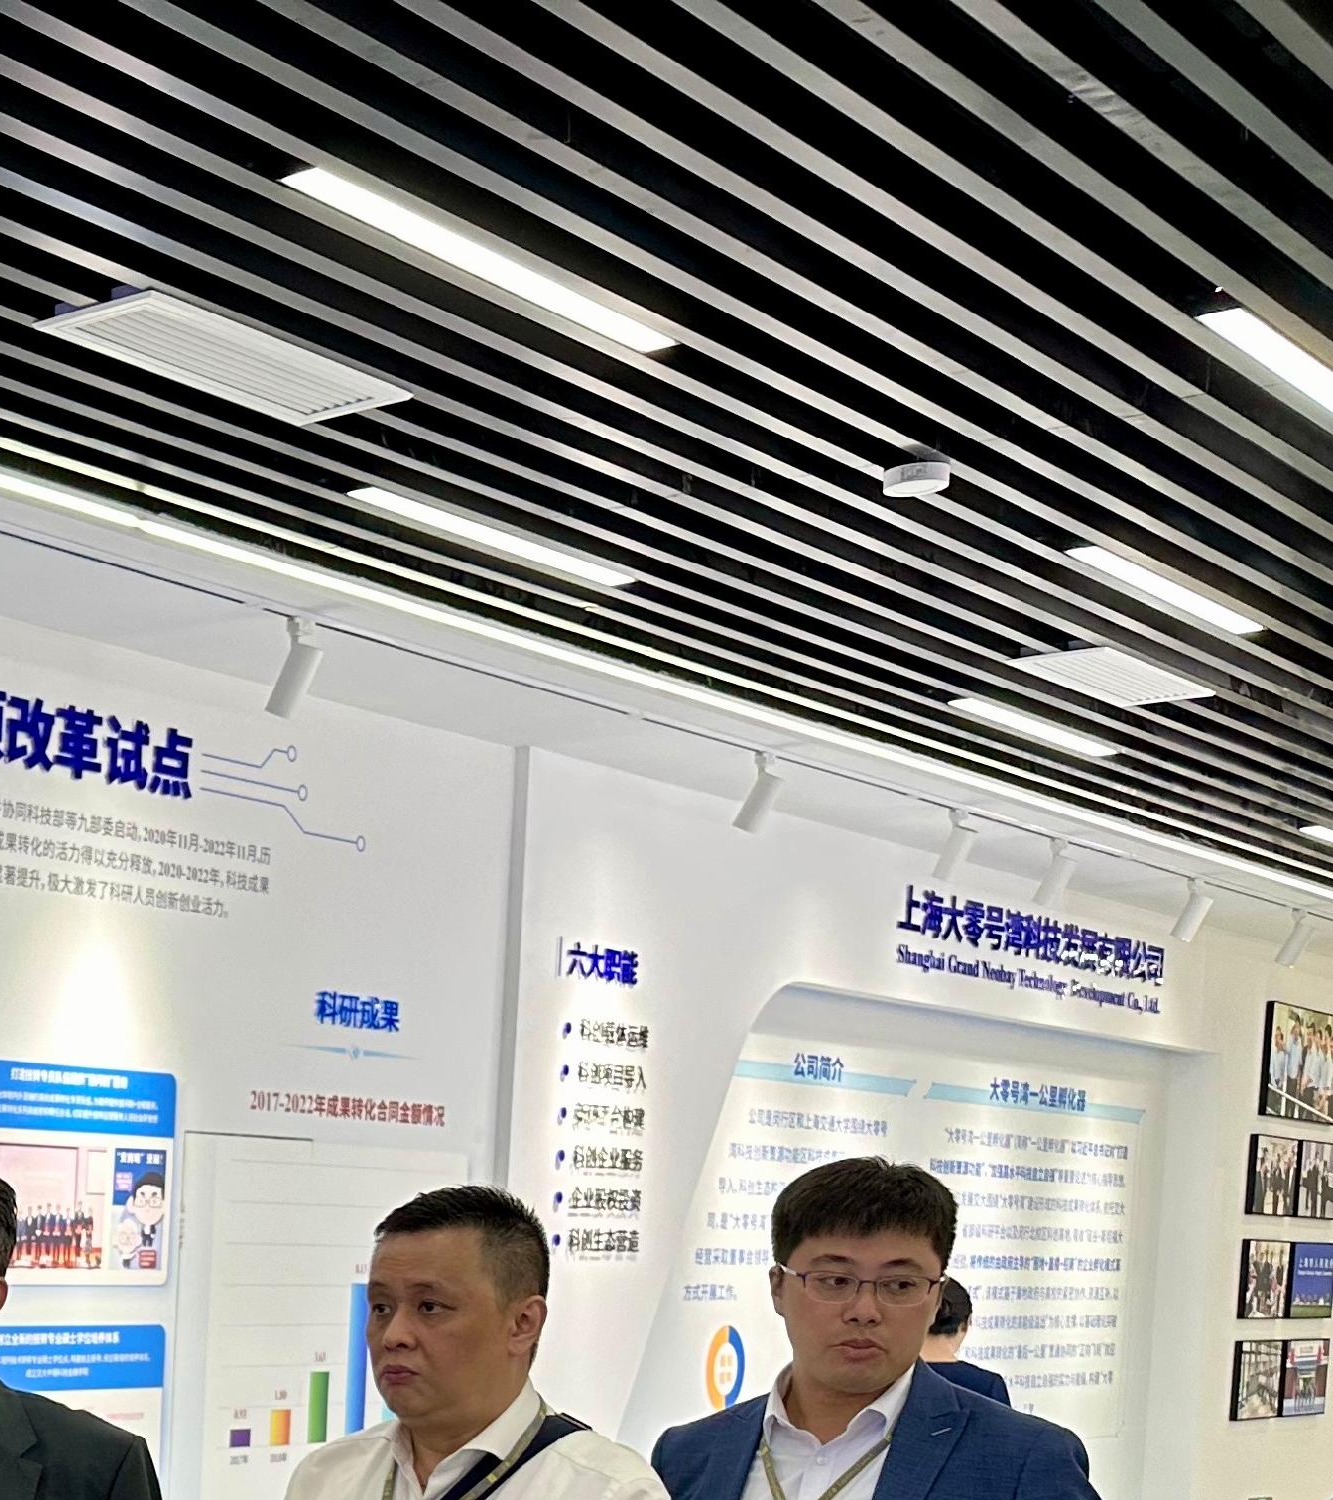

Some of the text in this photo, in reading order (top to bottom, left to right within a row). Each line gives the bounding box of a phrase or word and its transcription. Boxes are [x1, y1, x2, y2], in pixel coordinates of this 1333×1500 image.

[897, 885, 1165, 986] 上海大零号湾科技发展有限公司
[567, 942, 639, 985] 六大职能
[896, 944, 945, 973] Shanghai
[947, 954, 979, 978] Grand
[314, 989, 400, 1034] 科研成果
[793, 1053, 844, 1085] 公司简介
[250, 1090, 445, 1128] 2017-2022年成果转化合同金额情况
[989, 1077, 1087, 1112] 大零号湾一公里孵化器
[573, 1145, 643, 1172] 科创企业服务
[568, 1187, 641, 1211] 企业股权投资
[567, 1229, 639, 1253] 科创生态营造
